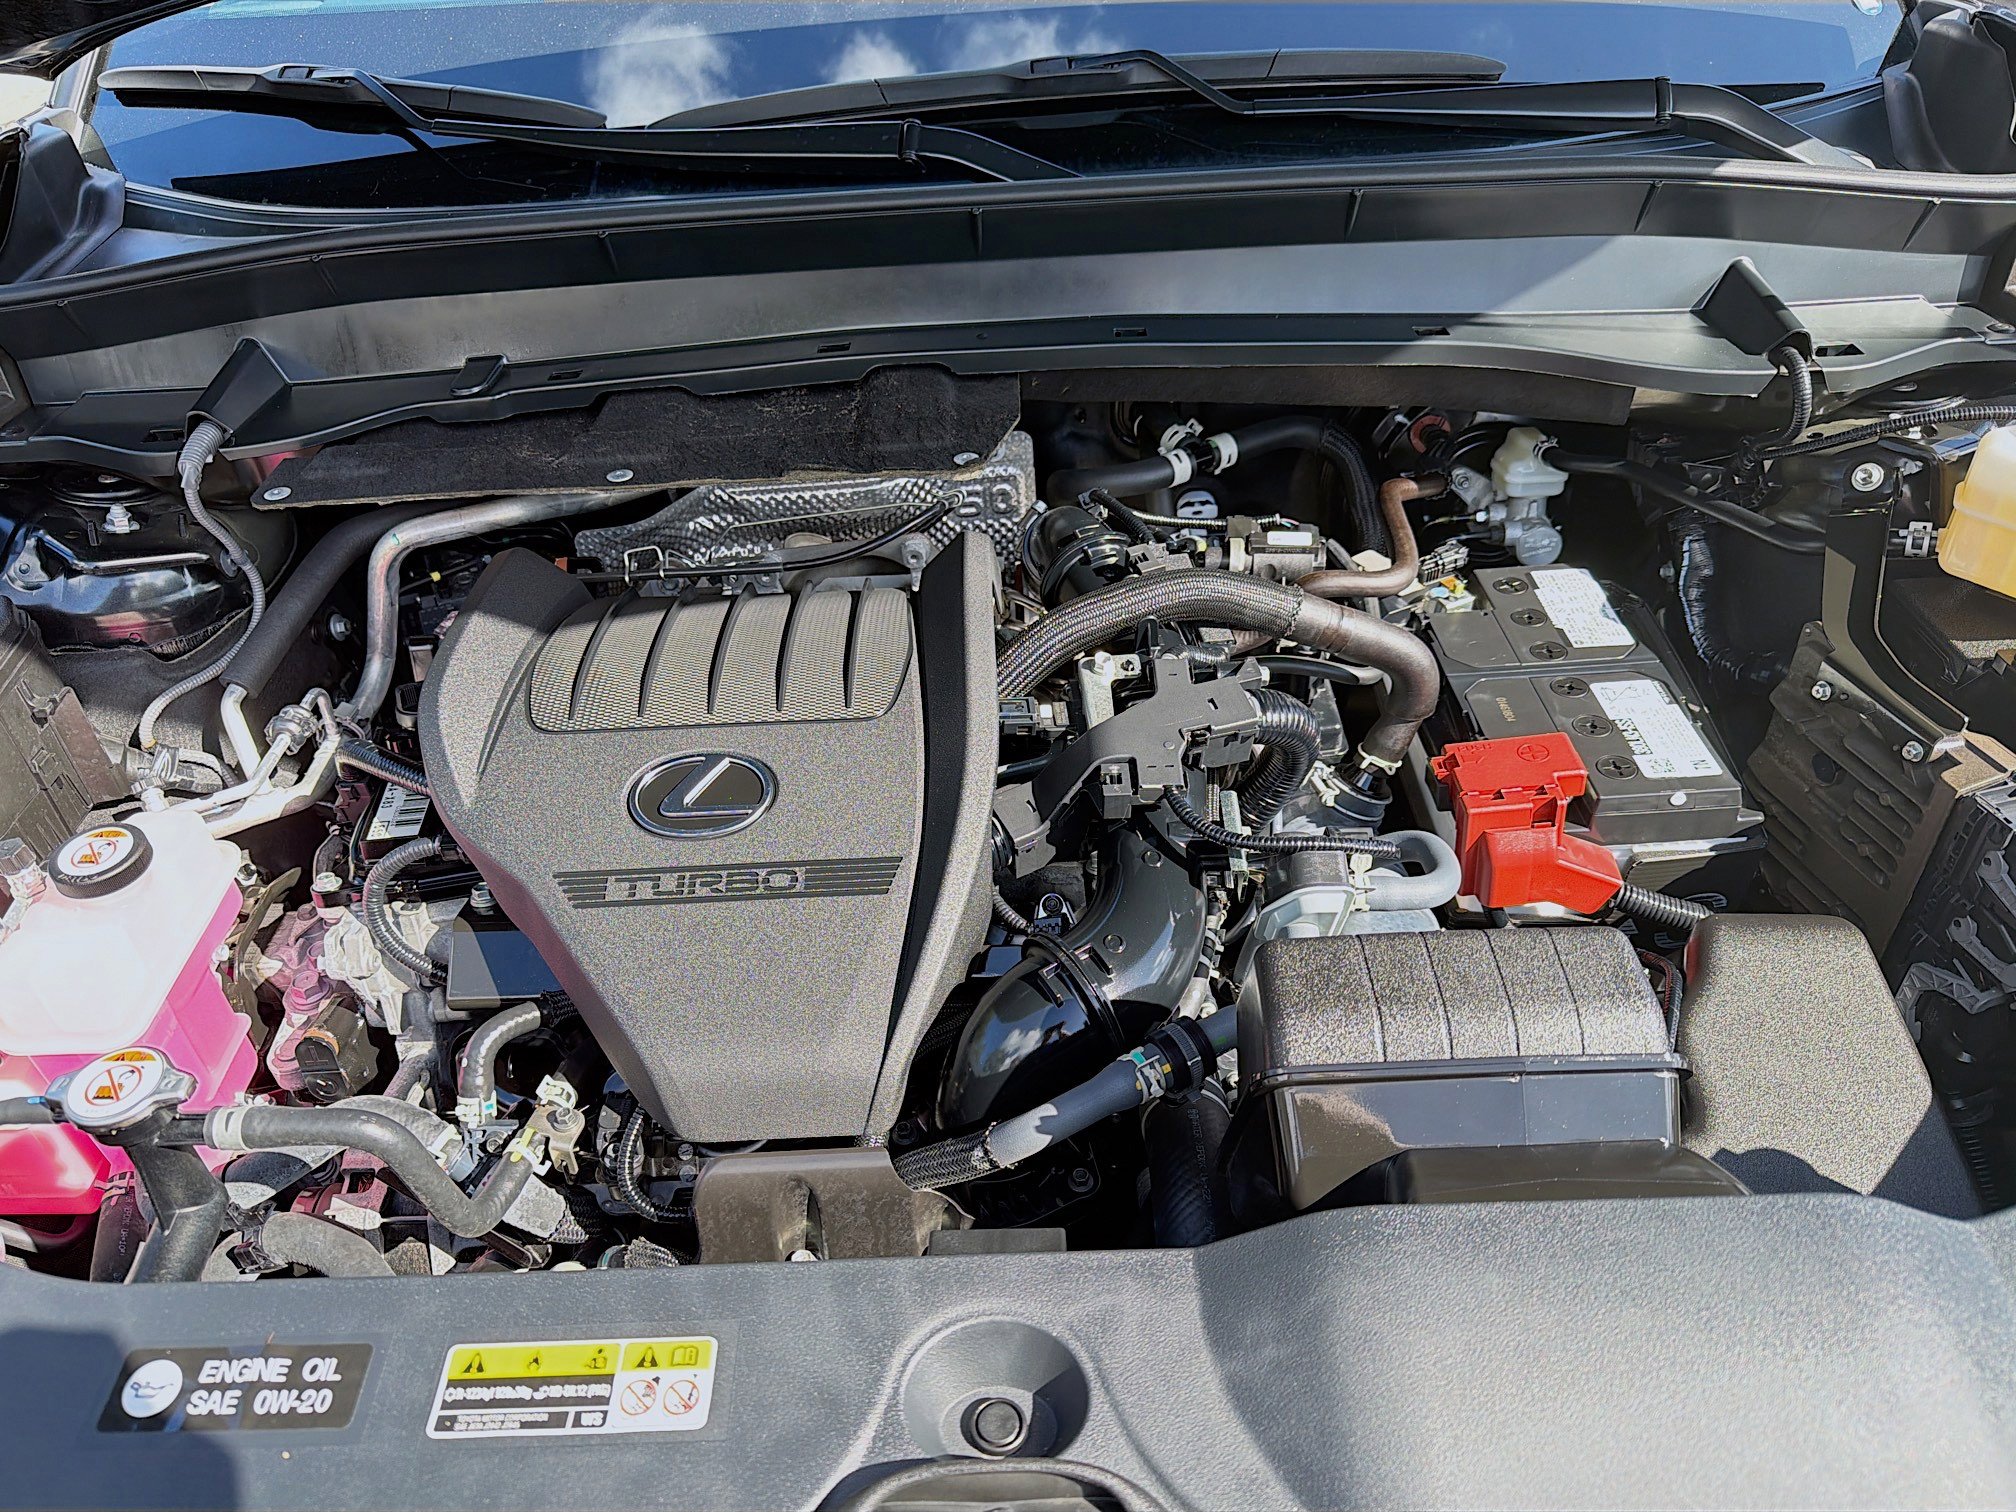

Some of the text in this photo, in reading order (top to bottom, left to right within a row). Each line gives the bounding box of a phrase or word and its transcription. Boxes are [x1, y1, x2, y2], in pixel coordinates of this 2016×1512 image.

[613, 868, 799, 898] TURBO
[198, 1357, 342, 1384] ENGINE OIL
[186, 1388, 333, 1416] SAE 0W-20
